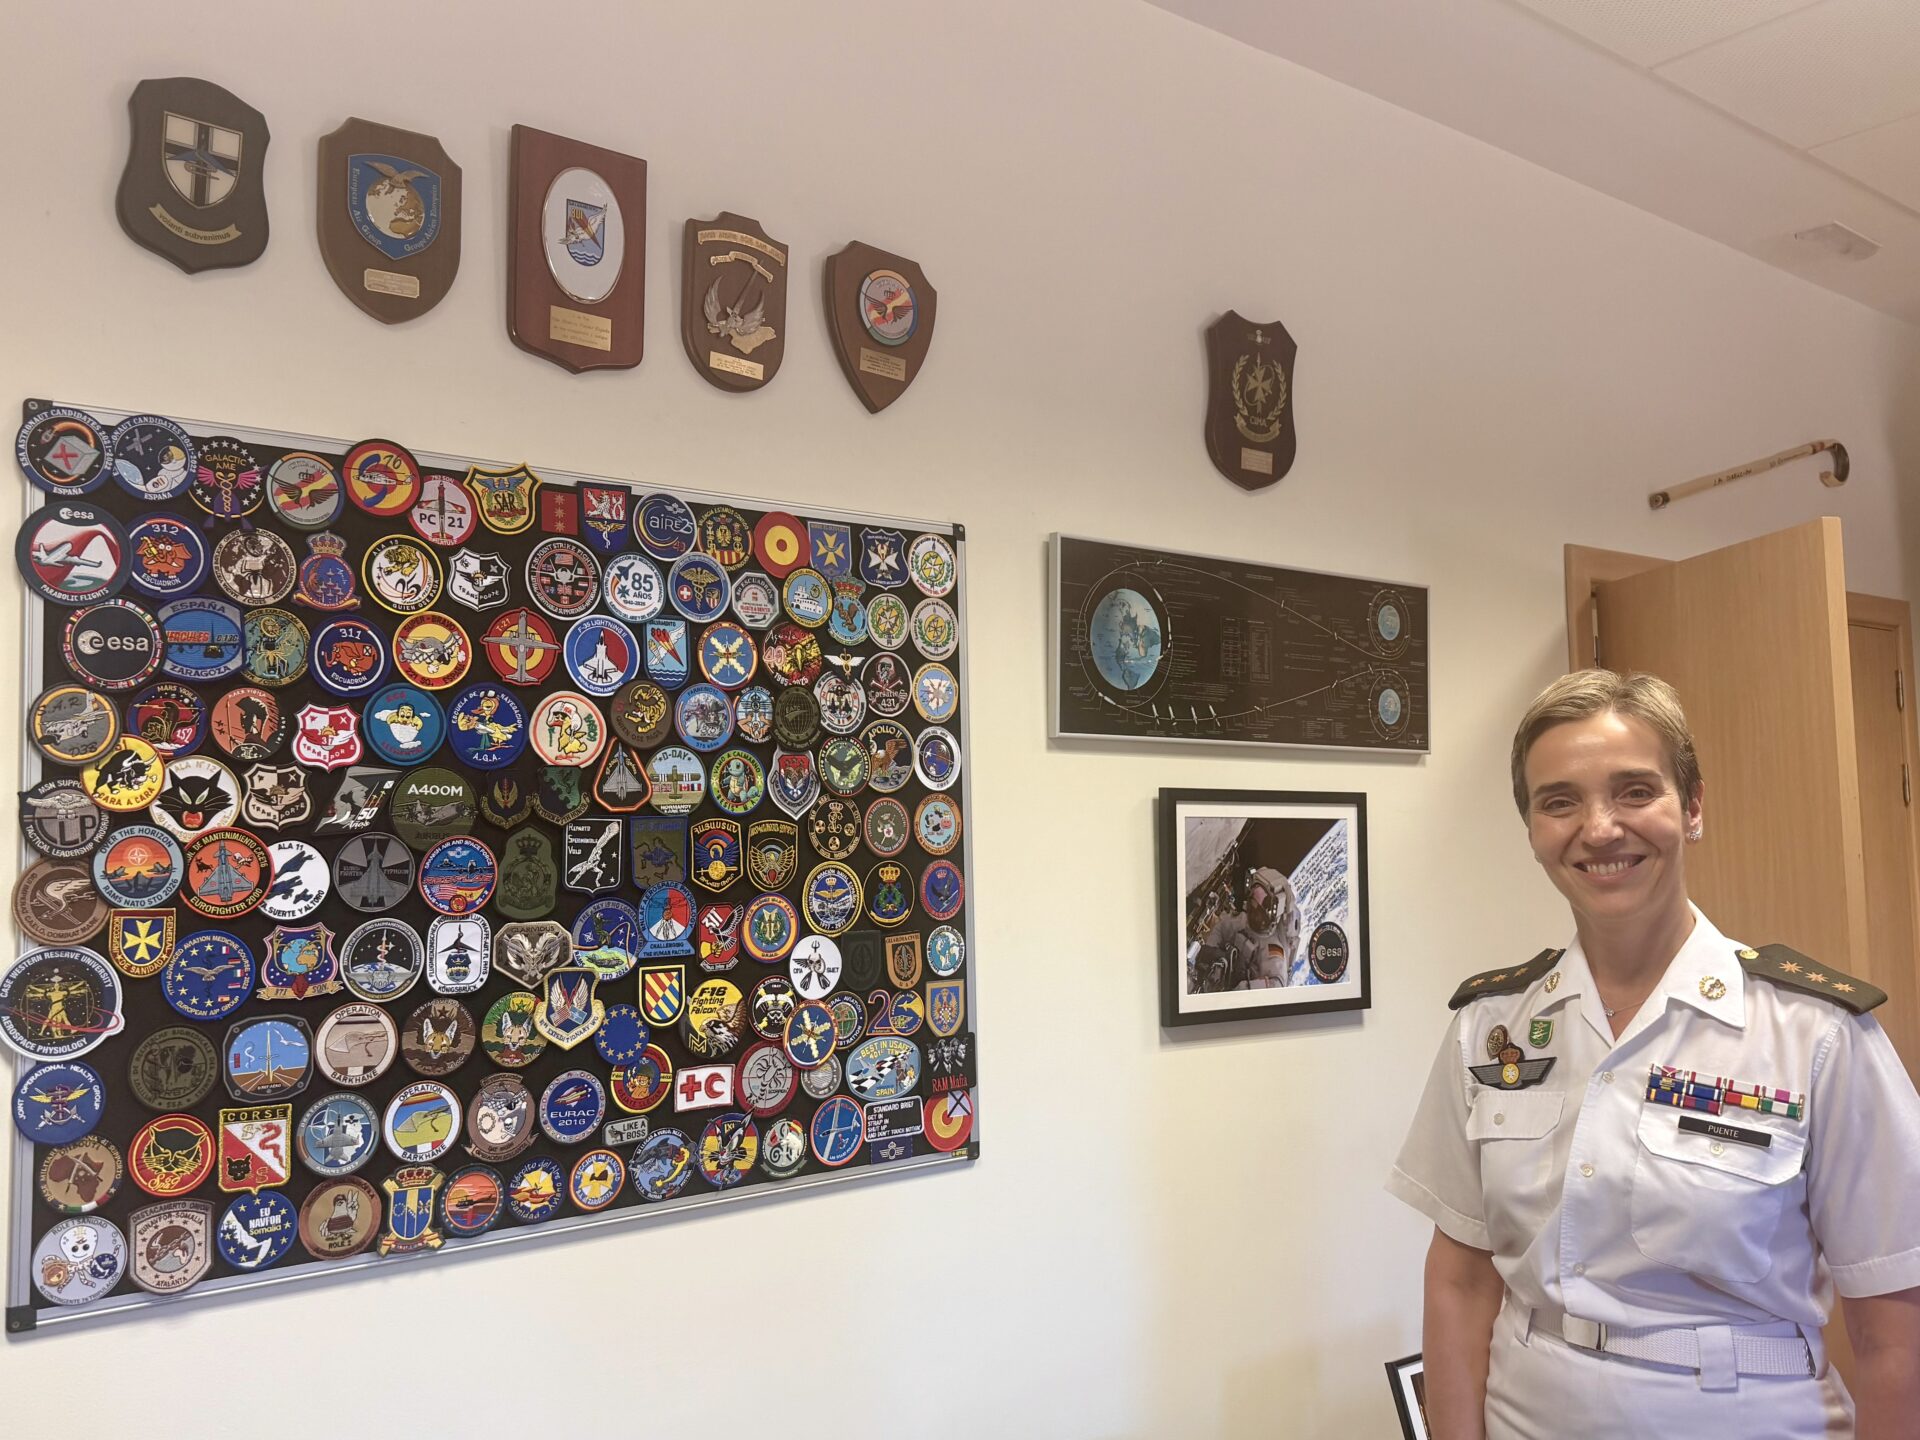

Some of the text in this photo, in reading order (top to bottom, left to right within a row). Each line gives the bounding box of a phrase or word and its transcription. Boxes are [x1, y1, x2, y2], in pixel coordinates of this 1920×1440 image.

[133, 416, 182, 436] CANDIDATES
[18, 409, 102, 467] ESA ASTRONAUT CANDIDATES
[205, 454, 247, 467] GALACTIC
[215, 461, 236, 471] AME
[52, 486, 84, 496] ESPAÑA
[144, 492, 173, 501] ESPAÑA
[494, 490, 516, 511] SAR
[73, 509, 95, 520] esa
[419, 513, 465, 529] PC 21
[152, 524, 180, 535] 312
[373, 542, 386, 556] ALA
[141, 573, 181, 587] ESCUADRON
[631, 572, 653, 592] 85
[40, 584, 109, 602] PARABOLIC FLIGHTS
[633, 590, 652, 600] AÑOS
[170, 601, 226, 614] ESPAÑA
[496, 618, 511, 631] T-21
[578, 620, 624, 635] F-35 LIGHTNING
[339, 628, 362, 640] 311
[107, 637, 149, 651] esa
[169, 665, 232, 678] ZARAGOZA
[331, 672, 367, 684] ESCUADRON
[157, 685, 177, 693] MARS
[452, 698, 468, 724] ESCUELA
[176, 728, 192, 743] 152
[868, 726, 896, 740] APOLLO
[38, 782, 56, 794] MSN
[407, 785, 463, 797] A400M
[98, 788, 156, 806] CARA A CARA
[271, 796, 284, 805] 37
[358, 807, 378, 819] 50
[26, 824, 94, 857] TACTICAL LEADERSHIP
[100, 827, 174, 855] OVER THE HORIZON
[194, 831, 257, 852] DE MANTENIMIENTO
[278, 843, 293, 851] ALA
[103, 885, 122, 904] RAMS
[124, 899, 146, 907] NATO
[147, 895, 162, 905] STO
[190, 888, 263, 914] EUROFIGHTER 2000
[268, 907, 296, 917] SUERTE
[184, 935, 211, 949] AVIATION
[212, 935, 240, 950] MEDICINE
[1, 950, 113, 998] CASE WESTERN RESERVE UNIVERSITY
[119, 960, 164, 976] DE SANIDAD
[698, 987, 728, 996] F-16
[176, 1000, 208, 1016] EUROPEAN
[221, 995, 240, 1012] GROUP
[692, 997, 725, 1006] Fighting
[334, 1006, 382, 1020] OPERATION
[691, 1006, 717, 1014] Falcon
[1, 1015, 88, 1054] AEROSPACE PHYSIOLOGY
[861, 1044, 878, 1057] BEST
[330, 1069, 378, 1085] BARKHANE
[18, 1064, 100, 1121] JOINT OPERATIONAL HEALTH GROUP
[399, 1085, 444, 1102] OPERATION
[876, 1088, 894, 1096] SPAIN
[873, 1101, 914, 1113] STANDARD BRIEF
[227, 1108, 284, 1122] CORSE
[550, 1109, 595, 1119] EURAC
[558, 1118, 586, 1127] 2016
[623, 1122, 639, 1132] LIKE
[626, 1129, 646, 1139] BOSS
[1708, 1125, 1739, 1138] PUENTE
[401, 1144, 447, 1161] BARKHANE
[132, 1201, 187, 1222] DESTACAMENTO
[260, 1207, 271, 1218] EU
[249, 1215, 282, 1230] NAVFOR
[249, 1223, 282, 1236] Somalia
[328, 1240, 346, 1249] ROLE
[155, 1276, 188, 1287] ATALANTA
